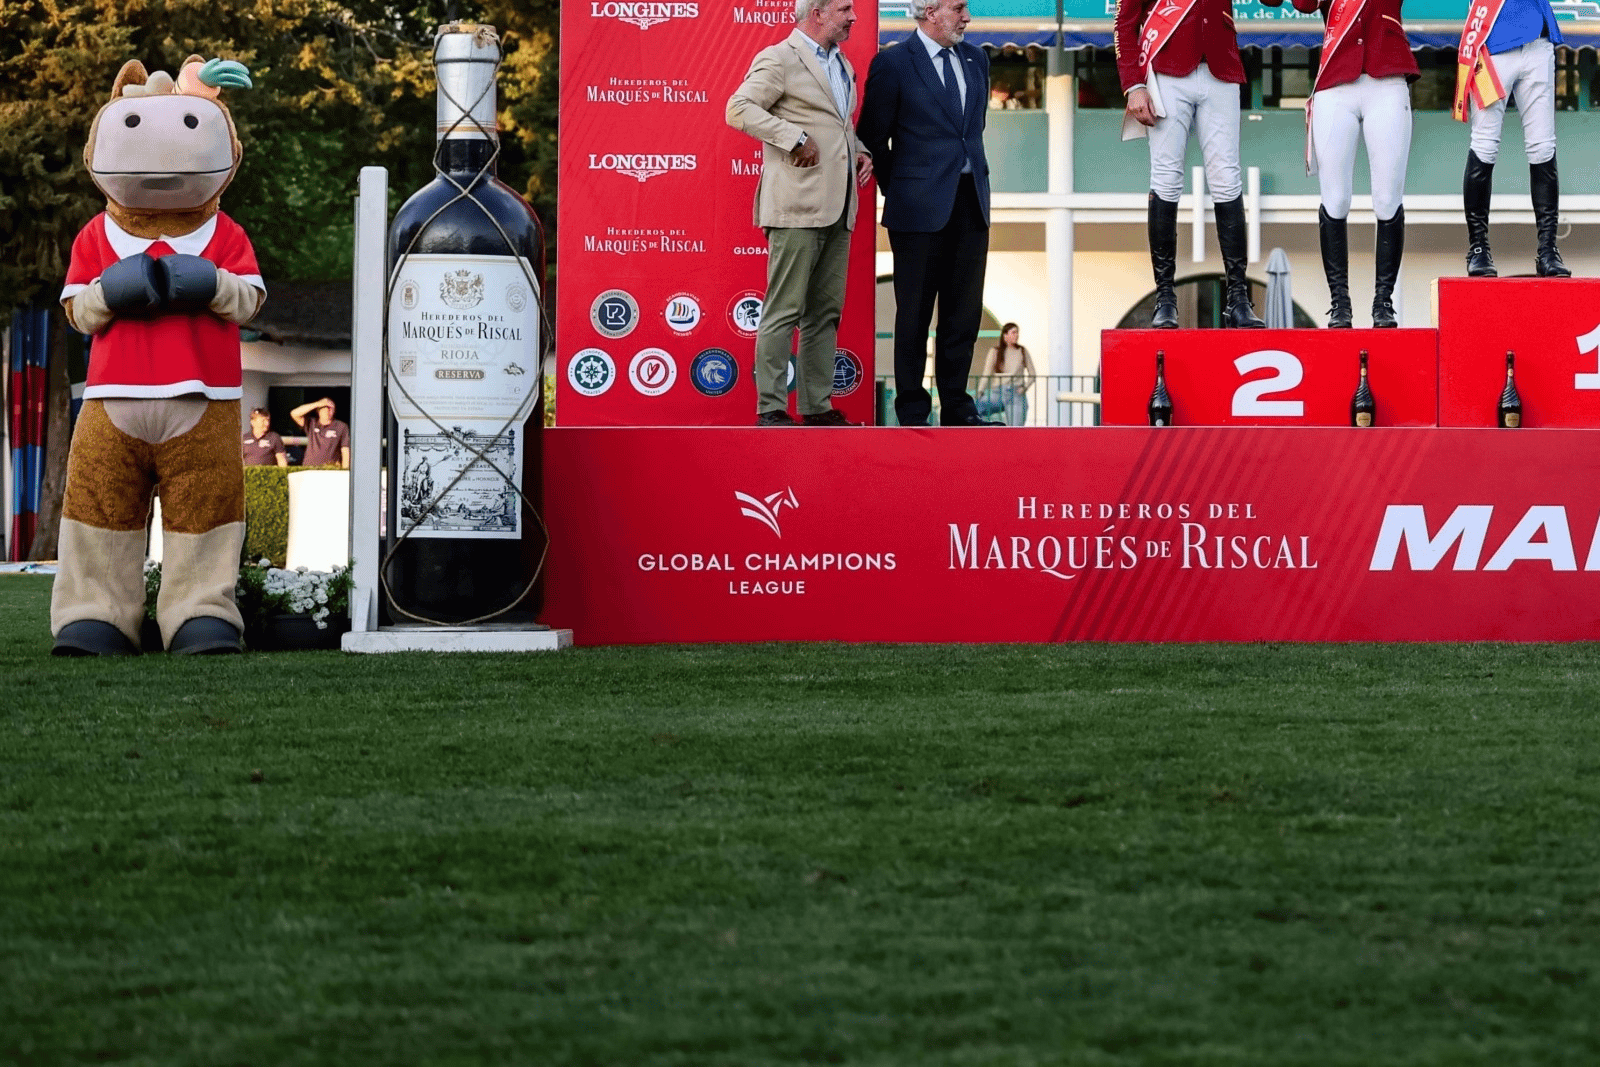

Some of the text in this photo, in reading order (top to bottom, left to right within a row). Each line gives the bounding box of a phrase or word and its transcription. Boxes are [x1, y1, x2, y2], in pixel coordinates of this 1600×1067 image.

[591, 2, 698, 17] LONGINES
[1462, 6, 1488, 59] 2025
[1139, 28, 1158, 66] 025
[610, 77, 667, 85] HEREDEROS
[587, 86, 649, 105] MARQUÉS
[663, 86, 708, 102] RISCAL
[589, 154, 696, 170] LONGINES
[607, 227, 664, 235] HEREDEROS
[584, 235, 647, 255] MARQUÉS
[661, 236, 706, 252] RISCAL
[734, 246, 768, 254] GLOBA
[422, 312, 482, 321] HEREDEROS
[403, 322, 462, 342] MARQUÉS
[478, 322, 522, 340] RISCAL
[441, 350, 479, 360] RIOJA
[438, 370, 481, 378] RESERVA
[1232, 350, 1303, 416] 2
[1018, 497, 1258, 518] HEREDEROS DEL
[948, 523, 1318, 579] MARQUÉS DE RISCAL
[638, 553, 897, 570] GLOBAL CHAMPIONS
[729, 581, 805, 594] LEAGUE
